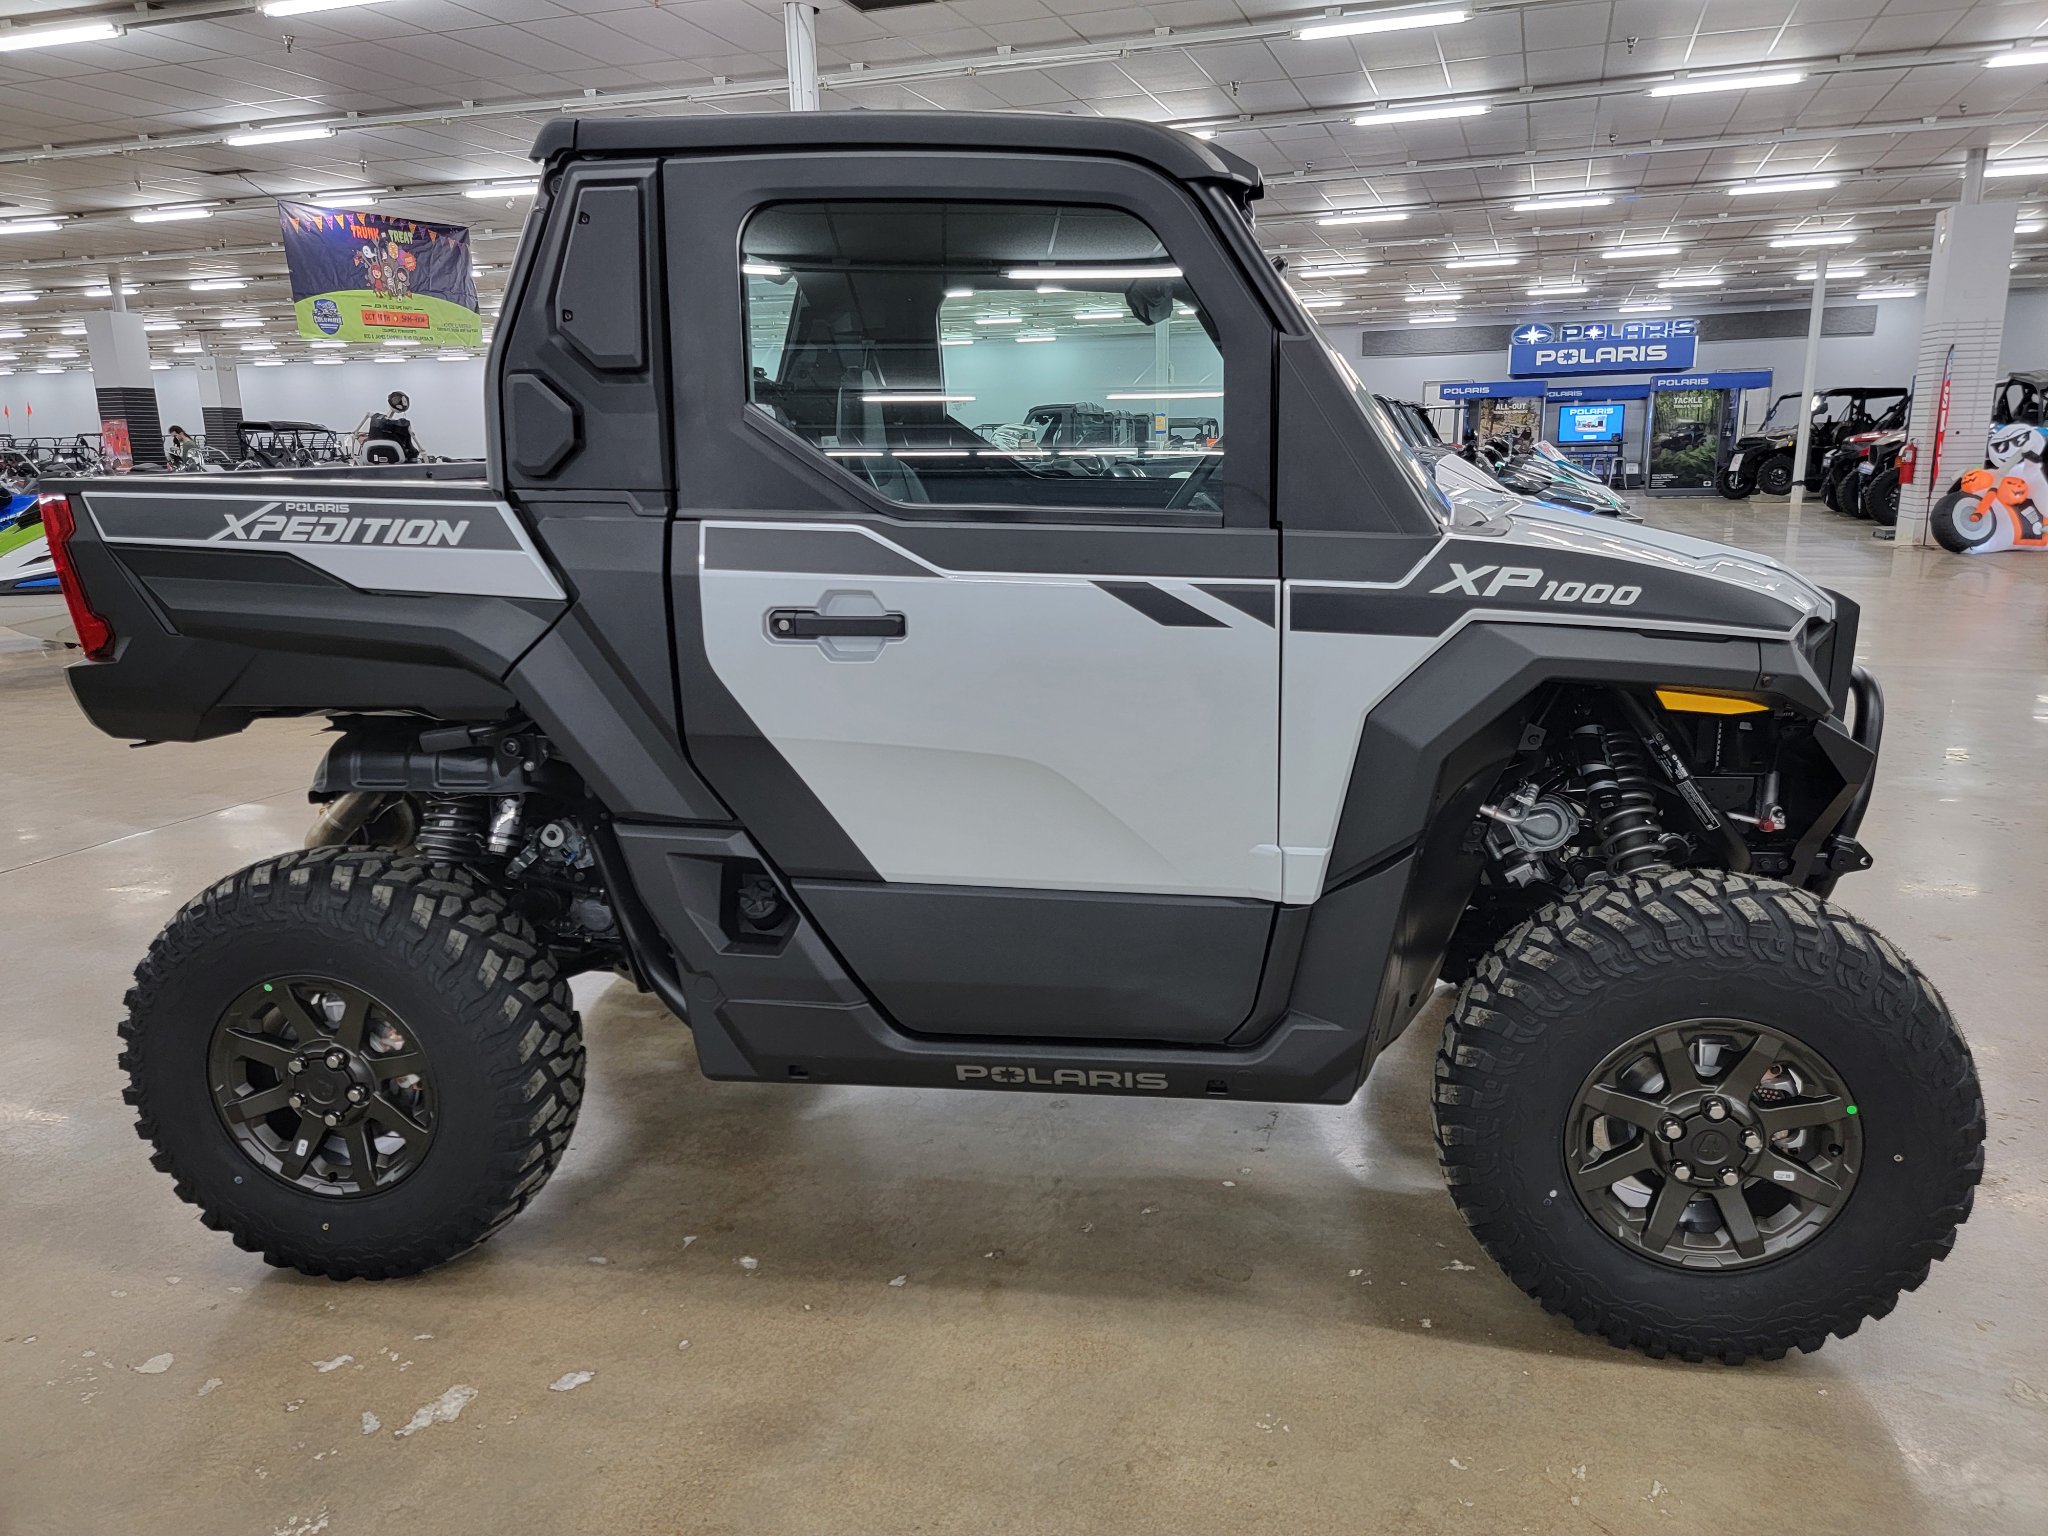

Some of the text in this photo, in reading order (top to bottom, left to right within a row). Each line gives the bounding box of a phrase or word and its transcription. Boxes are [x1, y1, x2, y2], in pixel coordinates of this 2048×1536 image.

[350, 225, 413, 244] TRUNK TREAT
[1560, 319, 1696, 342] POLARIS
[1536, 345, 1667, 366] POLARIS
[1658, 378, 1709, 386] POLARIS
[285, 502, 350, 513] POLARIS
[206, 502, 470, 546] XPEDITION
[956, 1065, 1169, 1090] POLARIS
